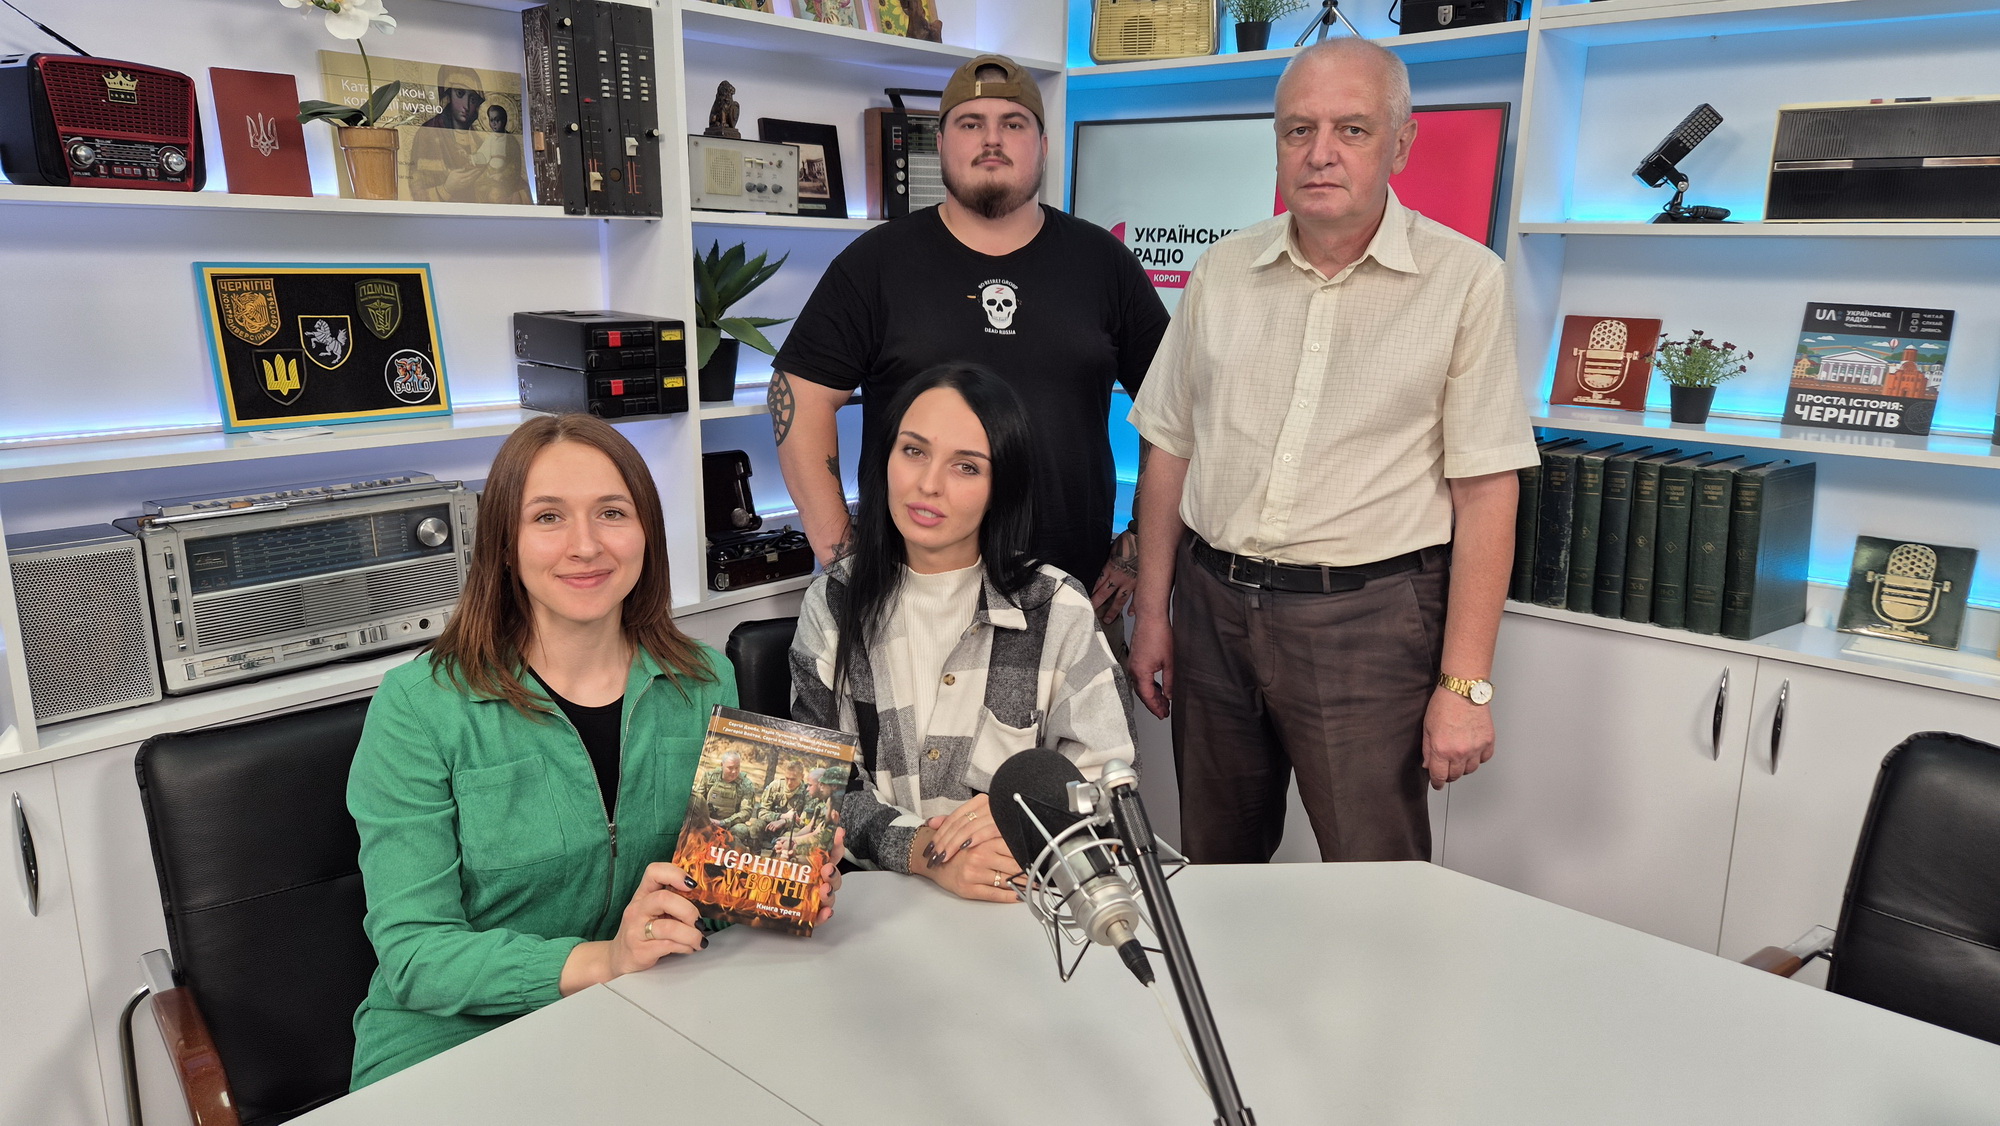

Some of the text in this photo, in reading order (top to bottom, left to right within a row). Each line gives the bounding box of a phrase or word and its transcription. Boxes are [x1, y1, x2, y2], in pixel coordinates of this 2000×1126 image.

[428, 91, 435, 100] з
[402, 102, 443, 114] музею
[1133, 248, 1184, 266] РАДІО
[1153, 274, 1181, 282] КОРОП
[1846, 310, 1892, 319] УКРАЇНСЬКЕ
[1796, 393, 1905, 411] ПРОСТА ІСТОРІЯ:
[1794, 404, 1901, 428] ЧЕРНІГІВ
[756, 902, 801, 917] Книга третя
